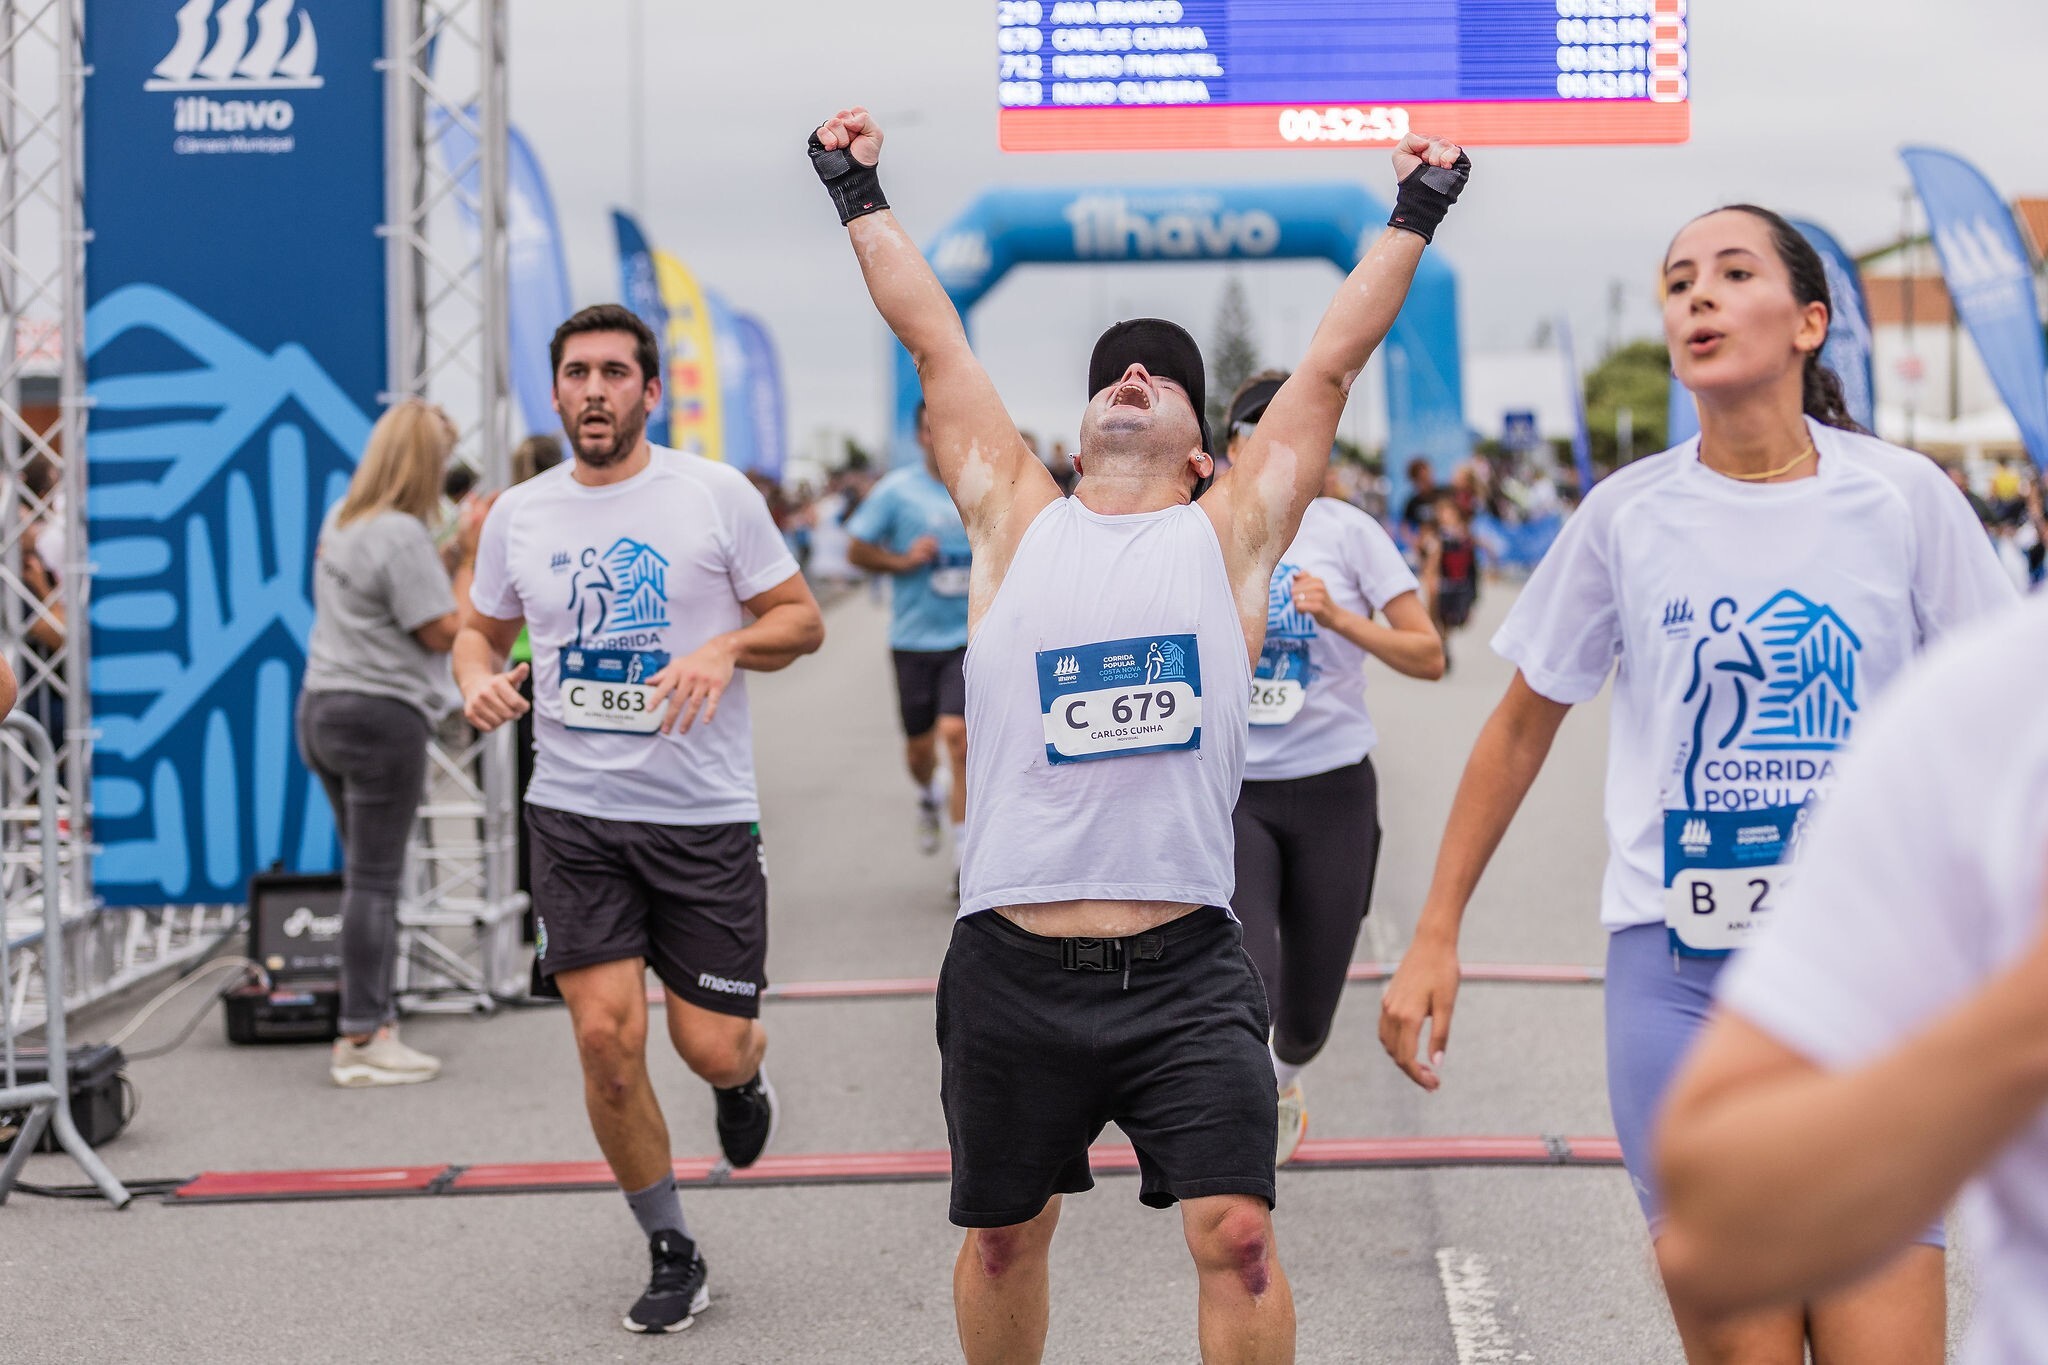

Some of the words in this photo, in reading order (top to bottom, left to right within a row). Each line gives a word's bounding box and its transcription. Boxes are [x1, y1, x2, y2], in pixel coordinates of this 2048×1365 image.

[1051, 28, 1132, 51] CARLOS
[1279, 107, 1410, 142] 00:52:53
[1103, 654, 1135, 663] CORRIDA
[1103, 660, 1136, 669] POPULAR
[1099, 668, 1121, 676] COSTA
[1122, 666, 1142, 674] NOVA
[1115, 672, 1139, 680] PRADO
[570, 686, 585, 706] C
[602, 690, 645, 712] 863
[1250, 685, 1287, 706] 265
[1065, 700, 1089, 730] C
[1112, 690, 1176, 724] 679
[1091, 728, 1128, 740] CARLOS
[1130, 724, 1164, 736] CUNHA
[1704, 760, 1836, 781] CORRIDA
[1704, 788, 1826, 811] POPULA
[1690, 881, 1716, 915] B
[697, 972, 758, 998] macron
